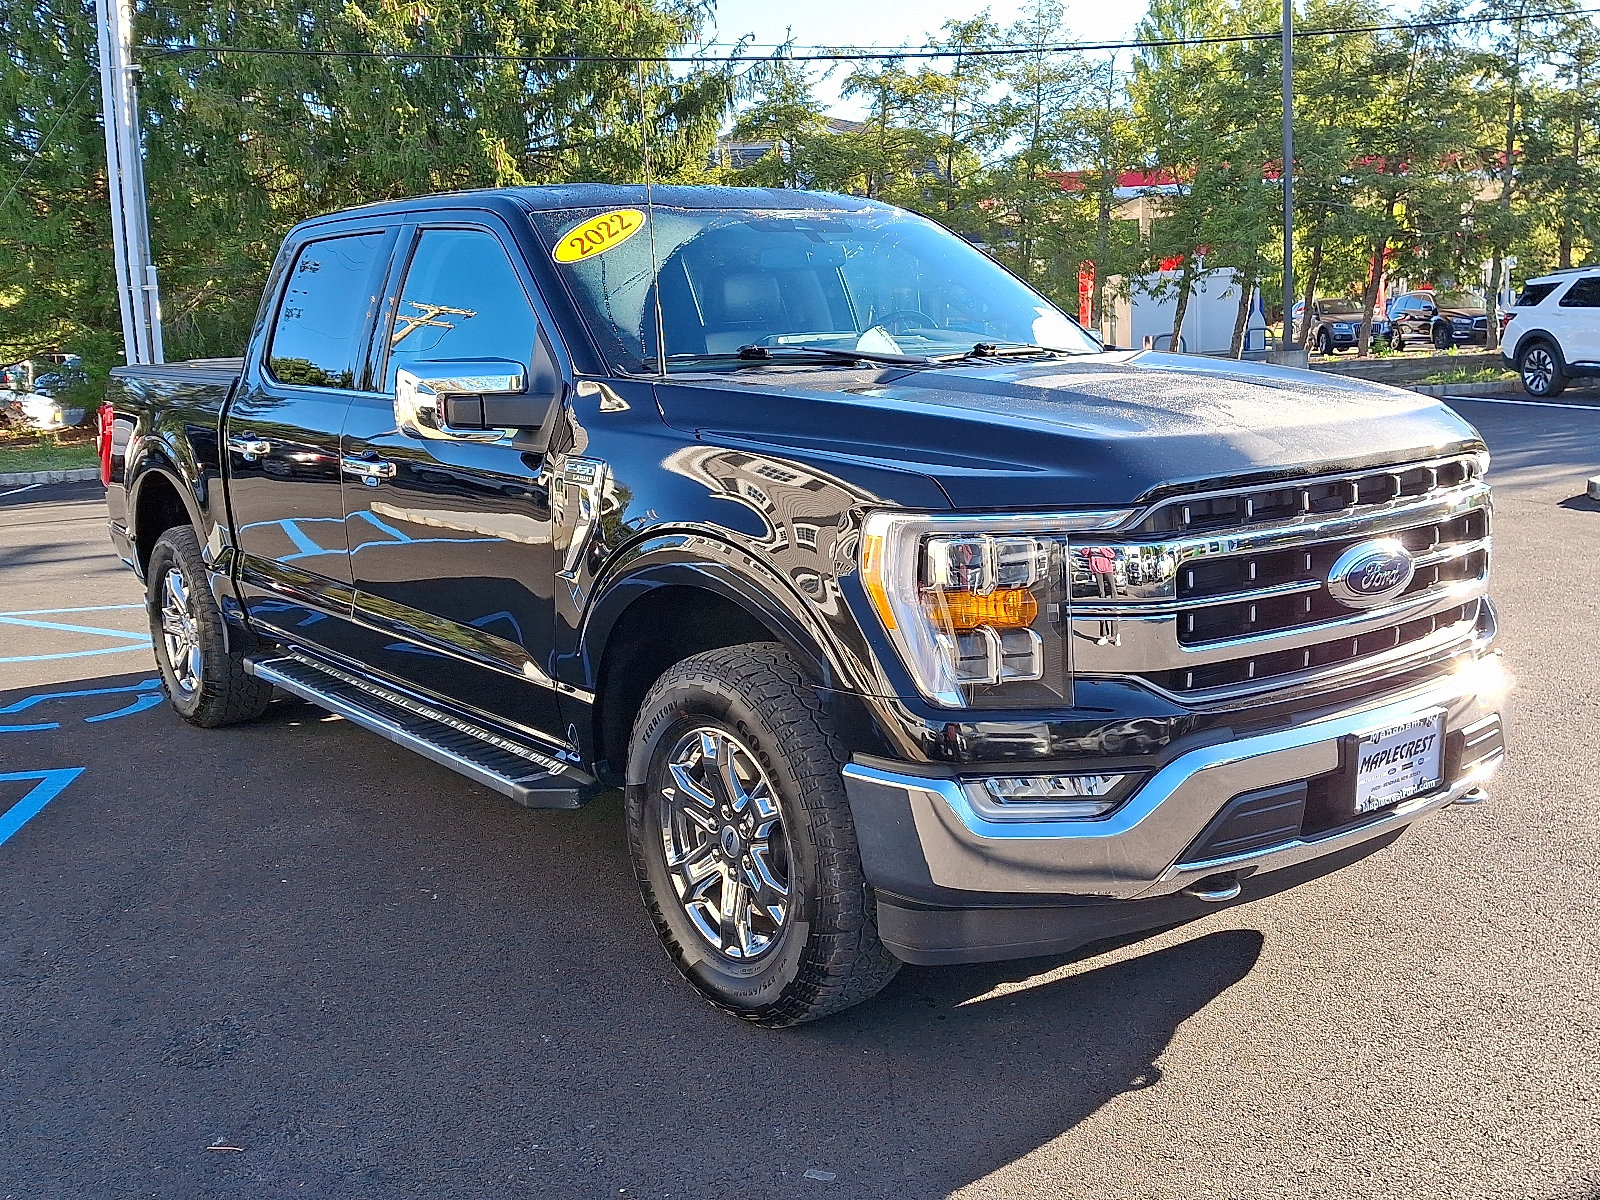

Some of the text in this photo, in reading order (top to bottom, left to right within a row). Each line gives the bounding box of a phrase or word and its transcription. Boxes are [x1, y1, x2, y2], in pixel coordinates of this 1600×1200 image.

[570, 214, 632, 255] 2022
[1361, 559, 1402, 590] Ford
[641, 699, 679, 744] TERRITORY
[1359, 733, 1436, 774] MAPLECREST
